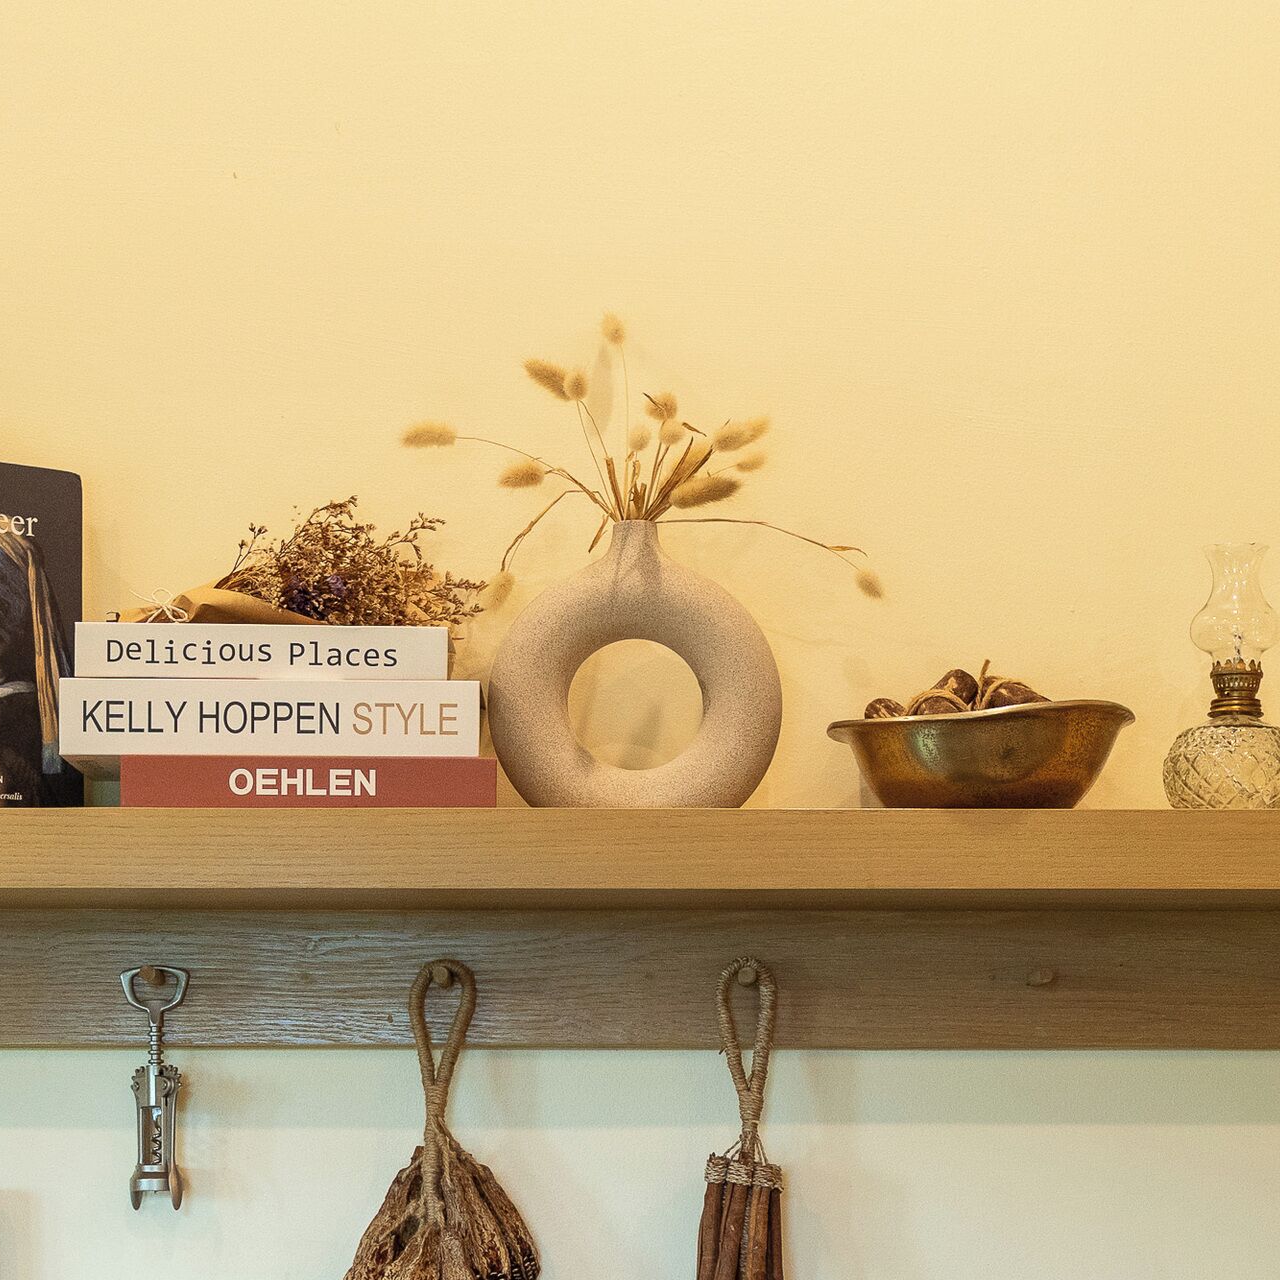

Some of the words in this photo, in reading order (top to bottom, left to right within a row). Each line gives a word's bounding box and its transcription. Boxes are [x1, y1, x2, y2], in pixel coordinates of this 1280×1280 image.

[106, 639, 272, 665] Delicious
[289, 642, 398, 668] Places
[82, 700, 188, 734] KELLY
[198, 701, 340, 736] HOPPEN
[352, 702, 459, 736] STYLE
[228, 768, 377, 797] OEHLEN
